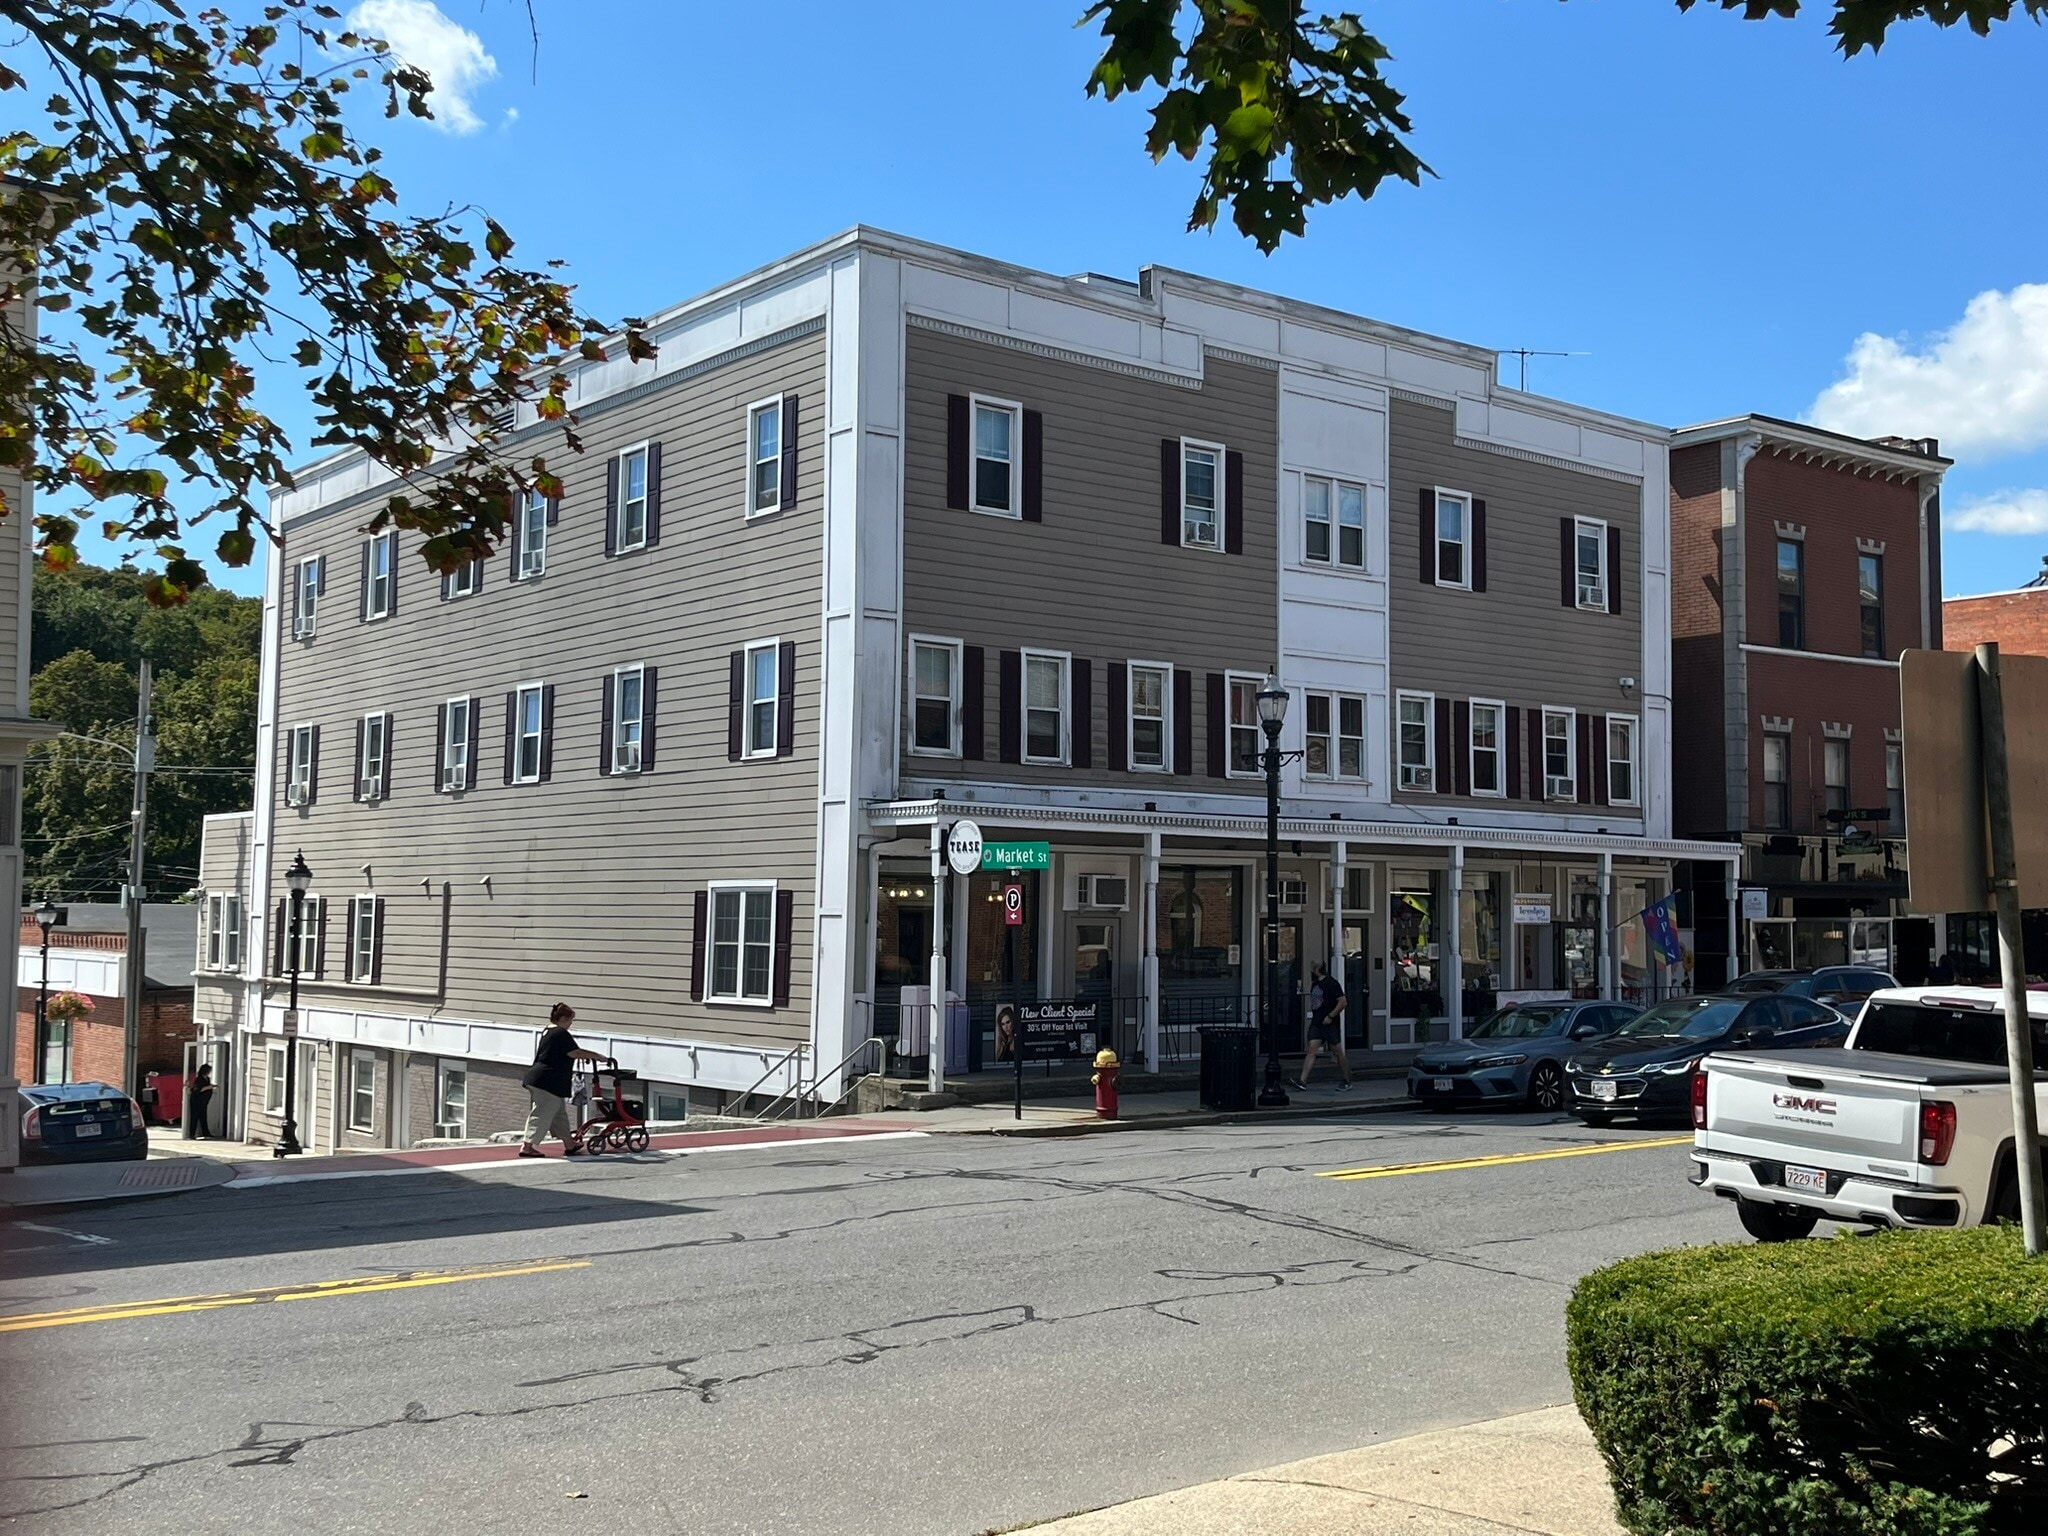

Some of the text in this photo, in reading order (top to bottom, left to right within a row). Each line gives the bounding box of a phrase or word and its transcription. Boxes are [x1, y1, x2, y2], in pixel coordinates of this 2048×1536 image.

[949, 841, 980, 853] TEASE
[996, 848, 1047, 863] Market St
[1010, 893, 1017, 906] P
[1020, 1003, 1096, 1022] New Client Special
[1027, 1024, 1040, 1032] 30%
[1052, 1023, 1065, 1031] Your
[1074, 1022, 1088, 1030] Visit
[1773, 1093, 1837, 1115] GMC
[1787, 1171, 1825, 1189] 7229 KE
